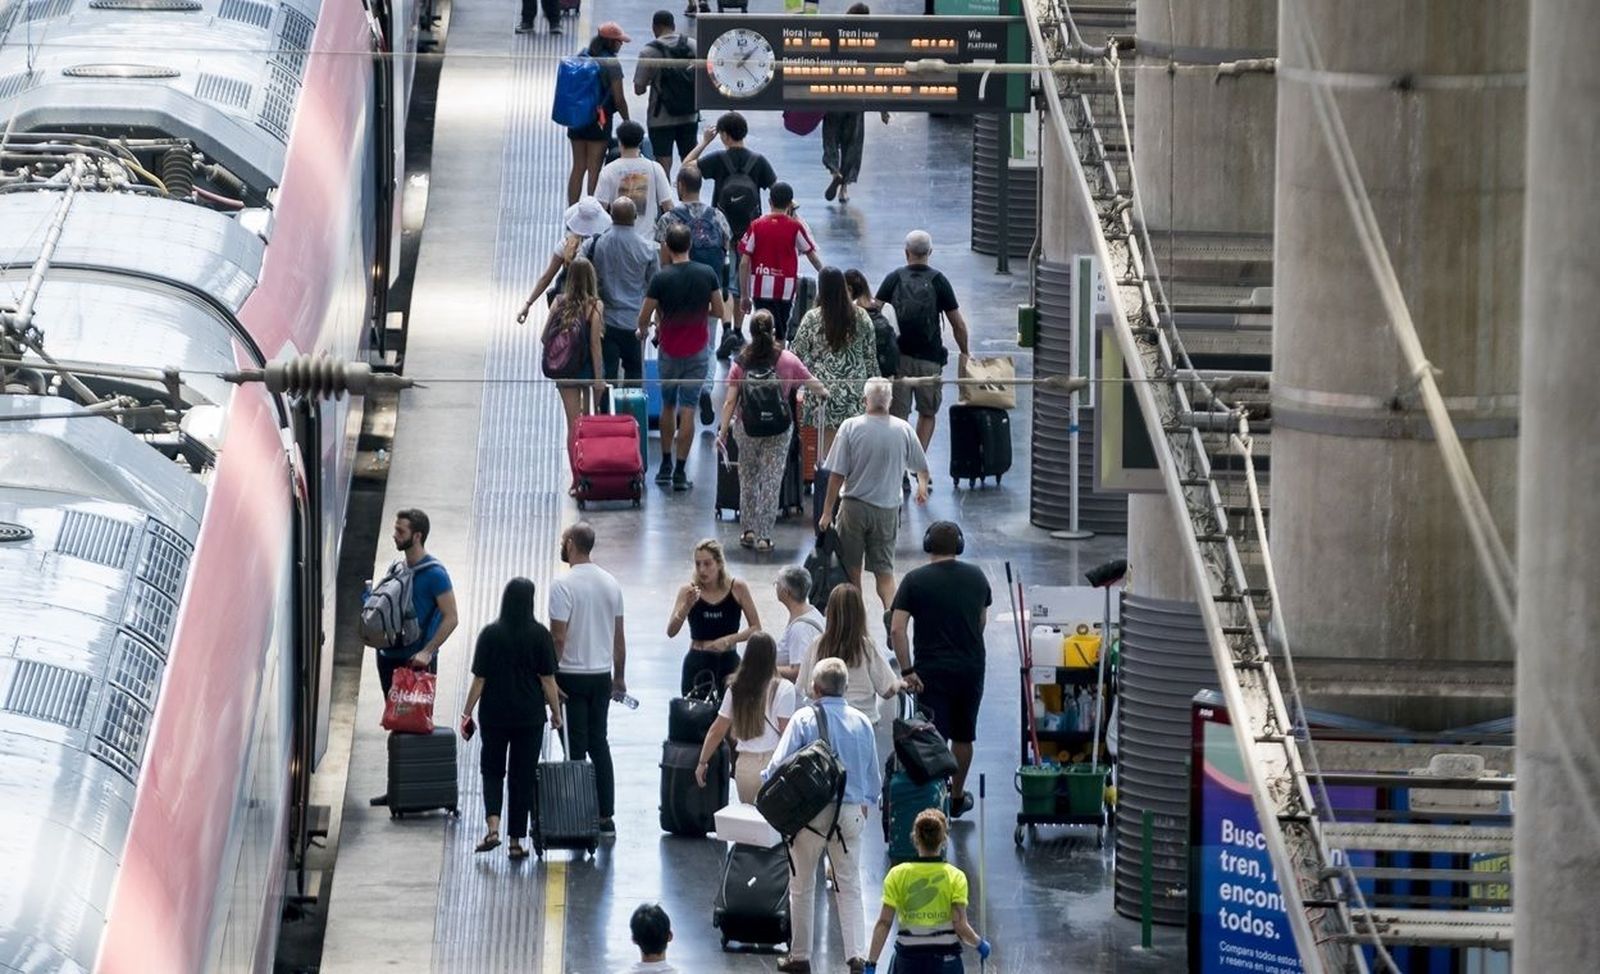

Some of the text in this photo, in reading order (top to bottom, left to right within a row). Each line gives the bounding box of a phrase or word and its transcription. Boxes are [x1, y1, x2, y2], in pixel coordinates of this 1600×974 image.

[782, 28, 803, 37] Hora
[838, 29, 857, 37] Tren
[755, 263, 770, 275] ria
[1221, 818, 1267, 850] Busc
[1219, 850, 1267, 883] tren,
[1219, 882, 1287, 913] encont
[1218, 907, 1281, 940] todos.
[1256, 949, 1277, 962] todos
